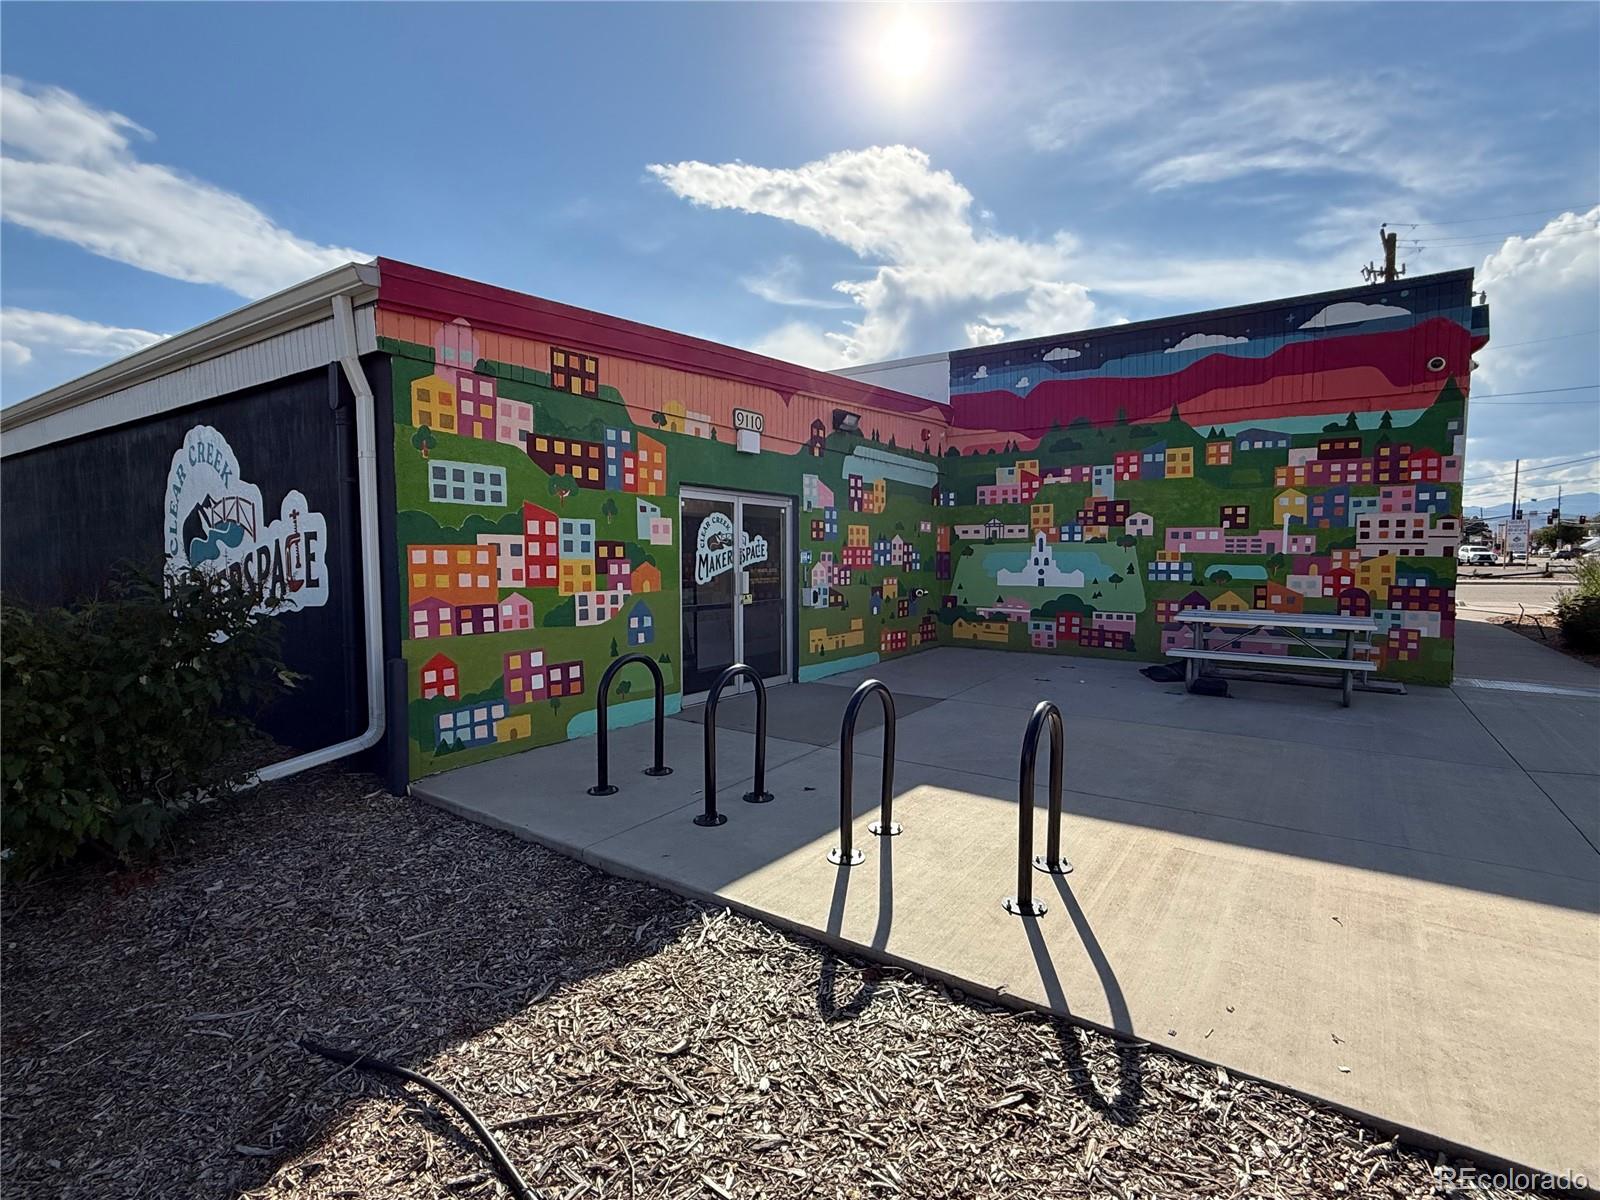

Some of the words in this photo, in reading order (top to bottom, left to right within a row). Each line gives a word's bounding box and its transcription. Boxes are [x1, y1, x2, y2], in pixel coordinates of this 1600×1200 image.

[737, 412, 762, 430] 9110
[169, 463, 187, 556] CLEAR
[188, 441, 233, 489] CREEK
[700, 521, 711, 548] CLEAR
[712, 516, 731, 531] CREEK
